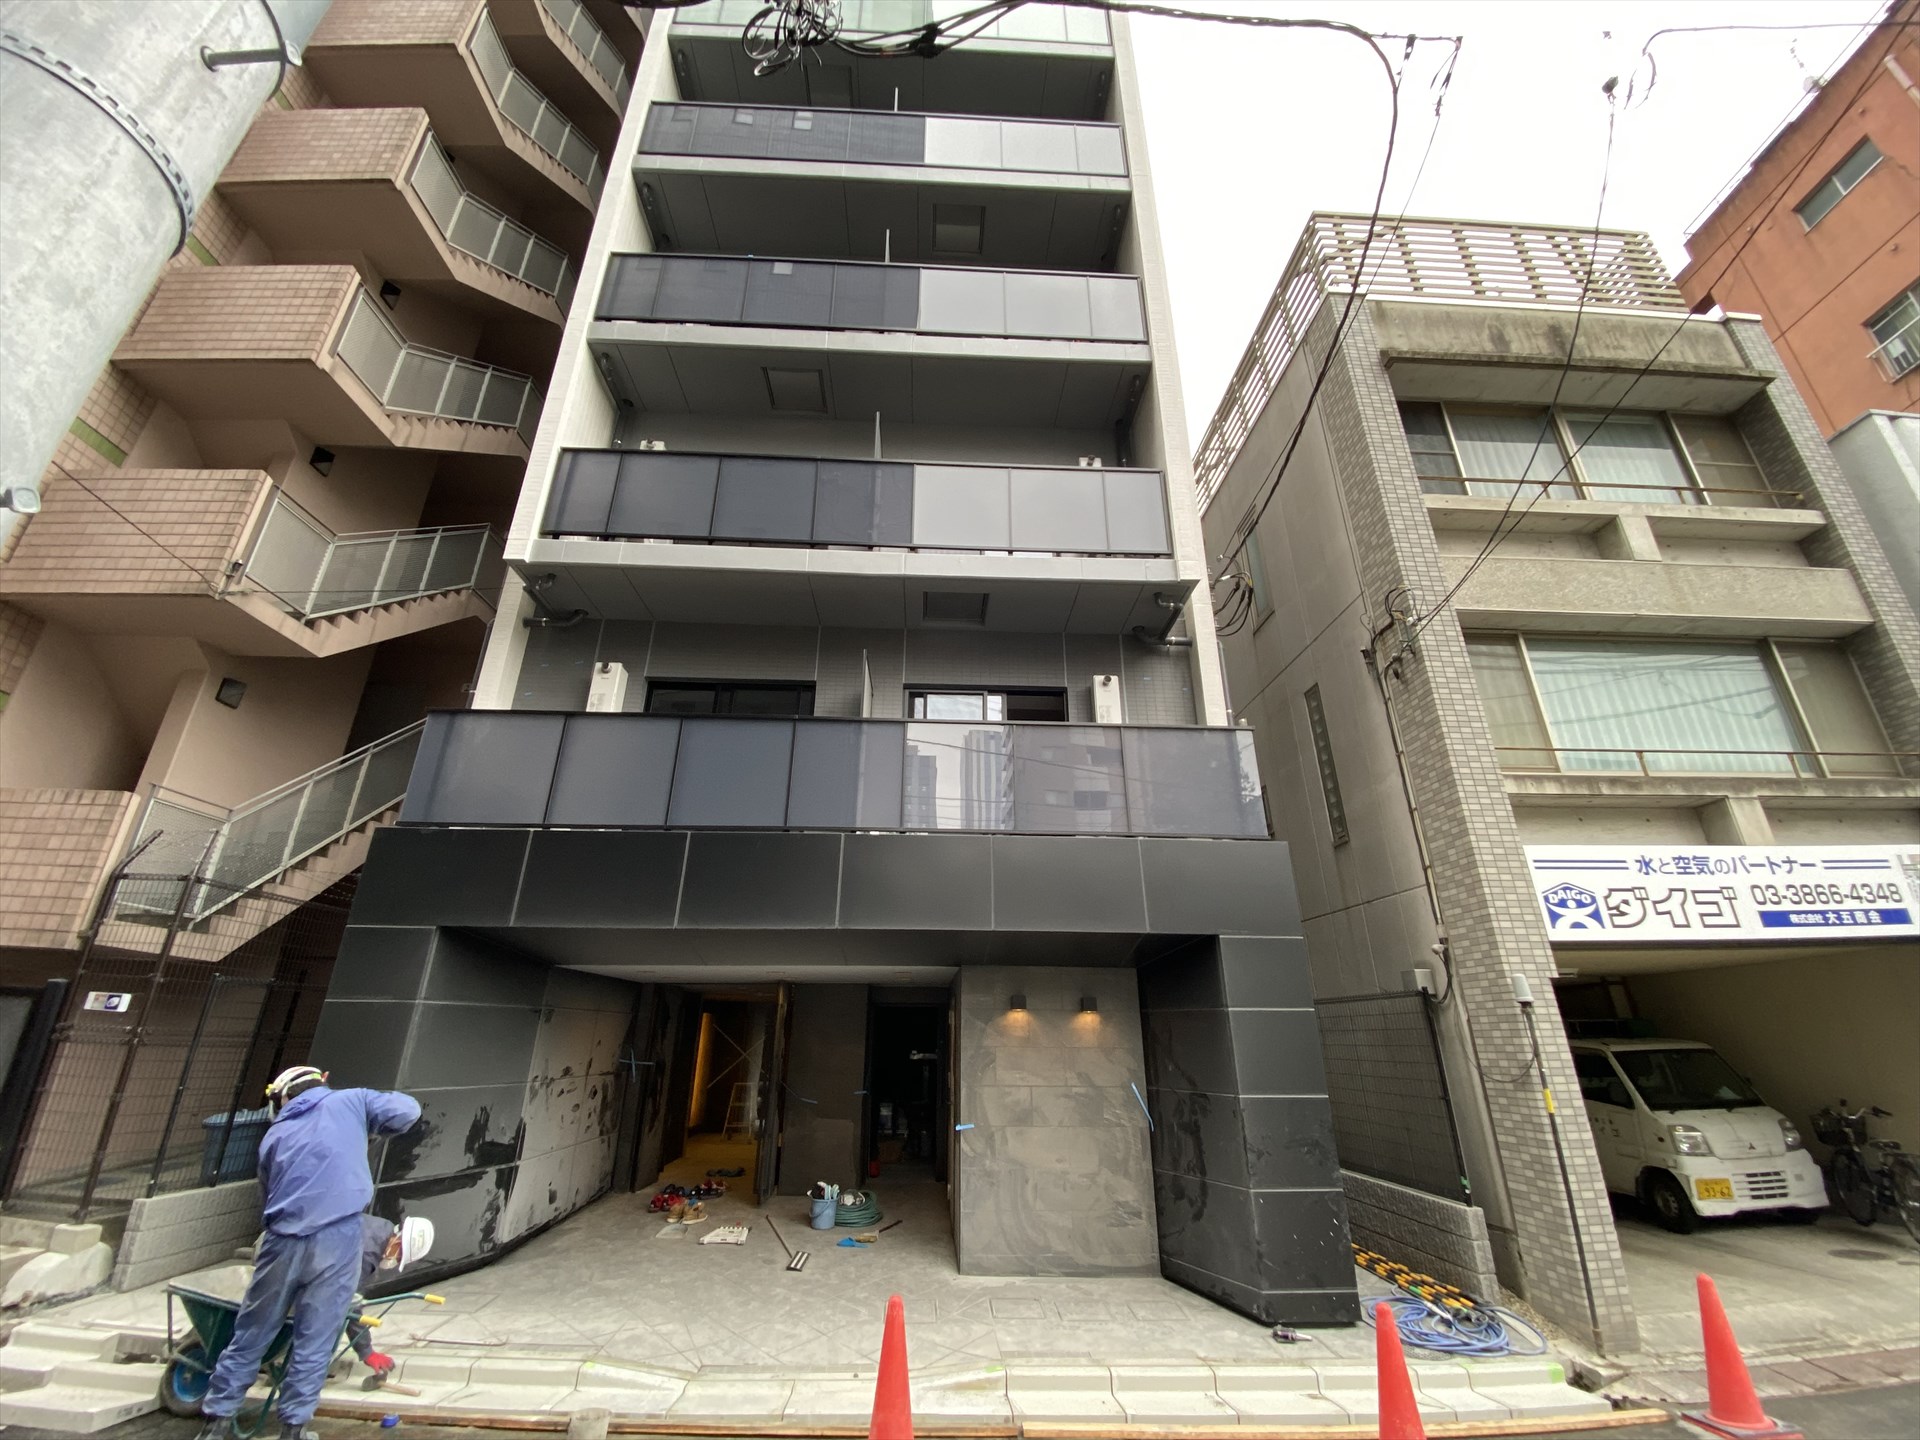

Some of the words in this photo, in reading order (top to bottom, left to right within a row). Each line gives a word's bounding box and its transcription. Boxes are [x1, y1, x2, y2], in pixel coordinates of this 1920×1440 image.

[1634, 854, 1817, 876] 水と空気のパートナー
[1547, 889, 1592, 904] DAIGO
[1750, 883, 1903, 905] 03-3866-4348
[1603, 886, 1741, 928] ダイゴ
